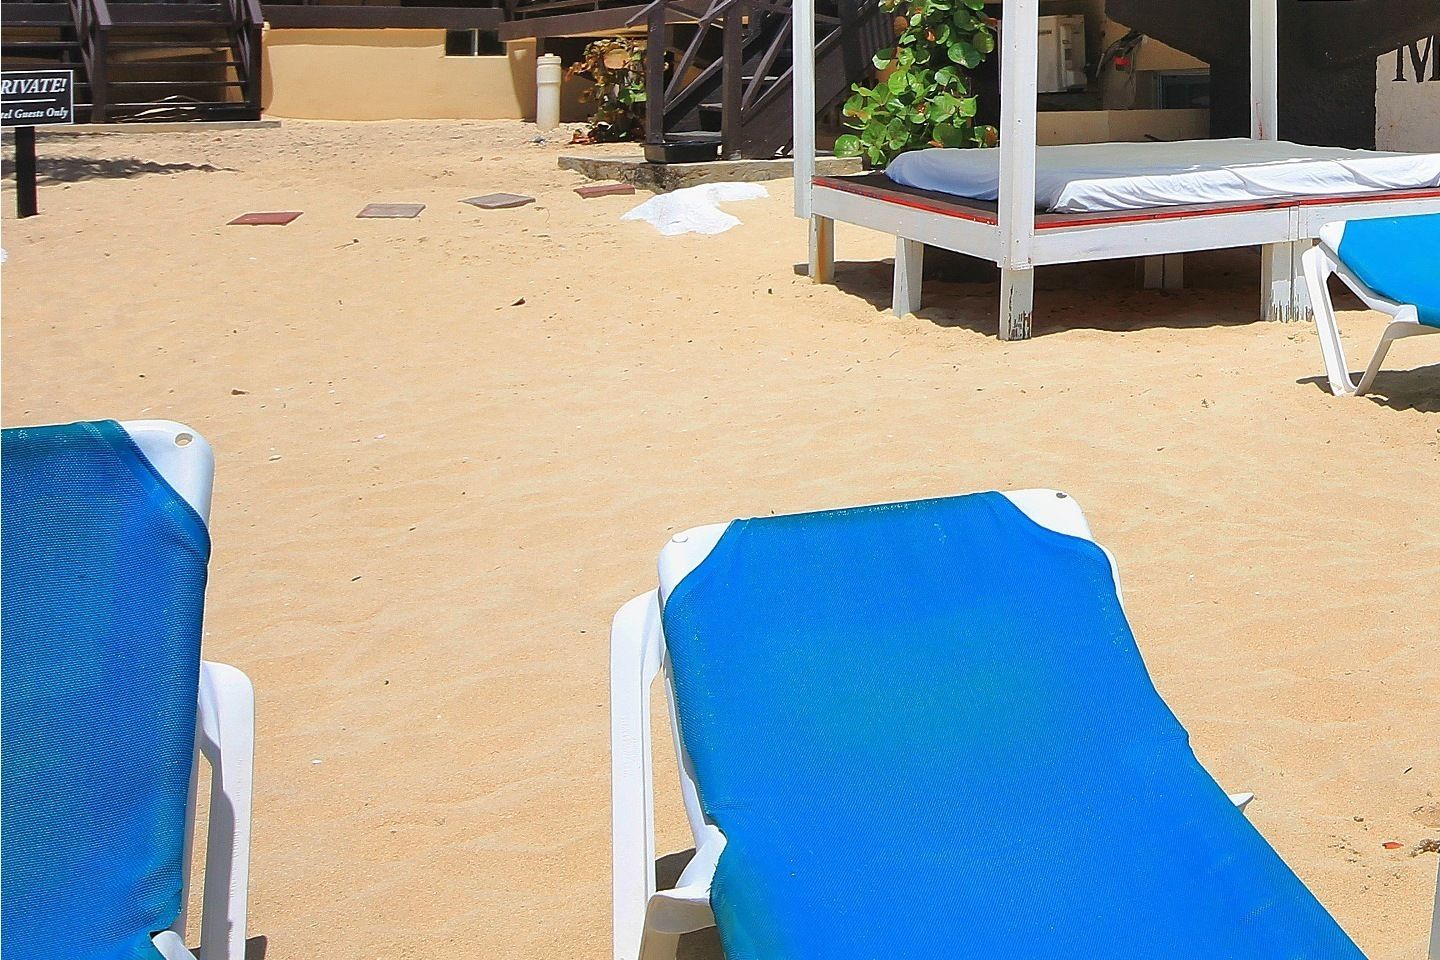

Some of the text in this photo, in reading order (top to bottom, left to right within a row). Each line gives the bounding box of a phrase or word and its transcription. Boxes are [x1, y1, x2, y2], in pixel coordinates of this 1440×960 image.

[1, 78, 68, 94] RIVATE!
[14, 109, 45, 119] Guests
[46, 107, 69, 119] Only
